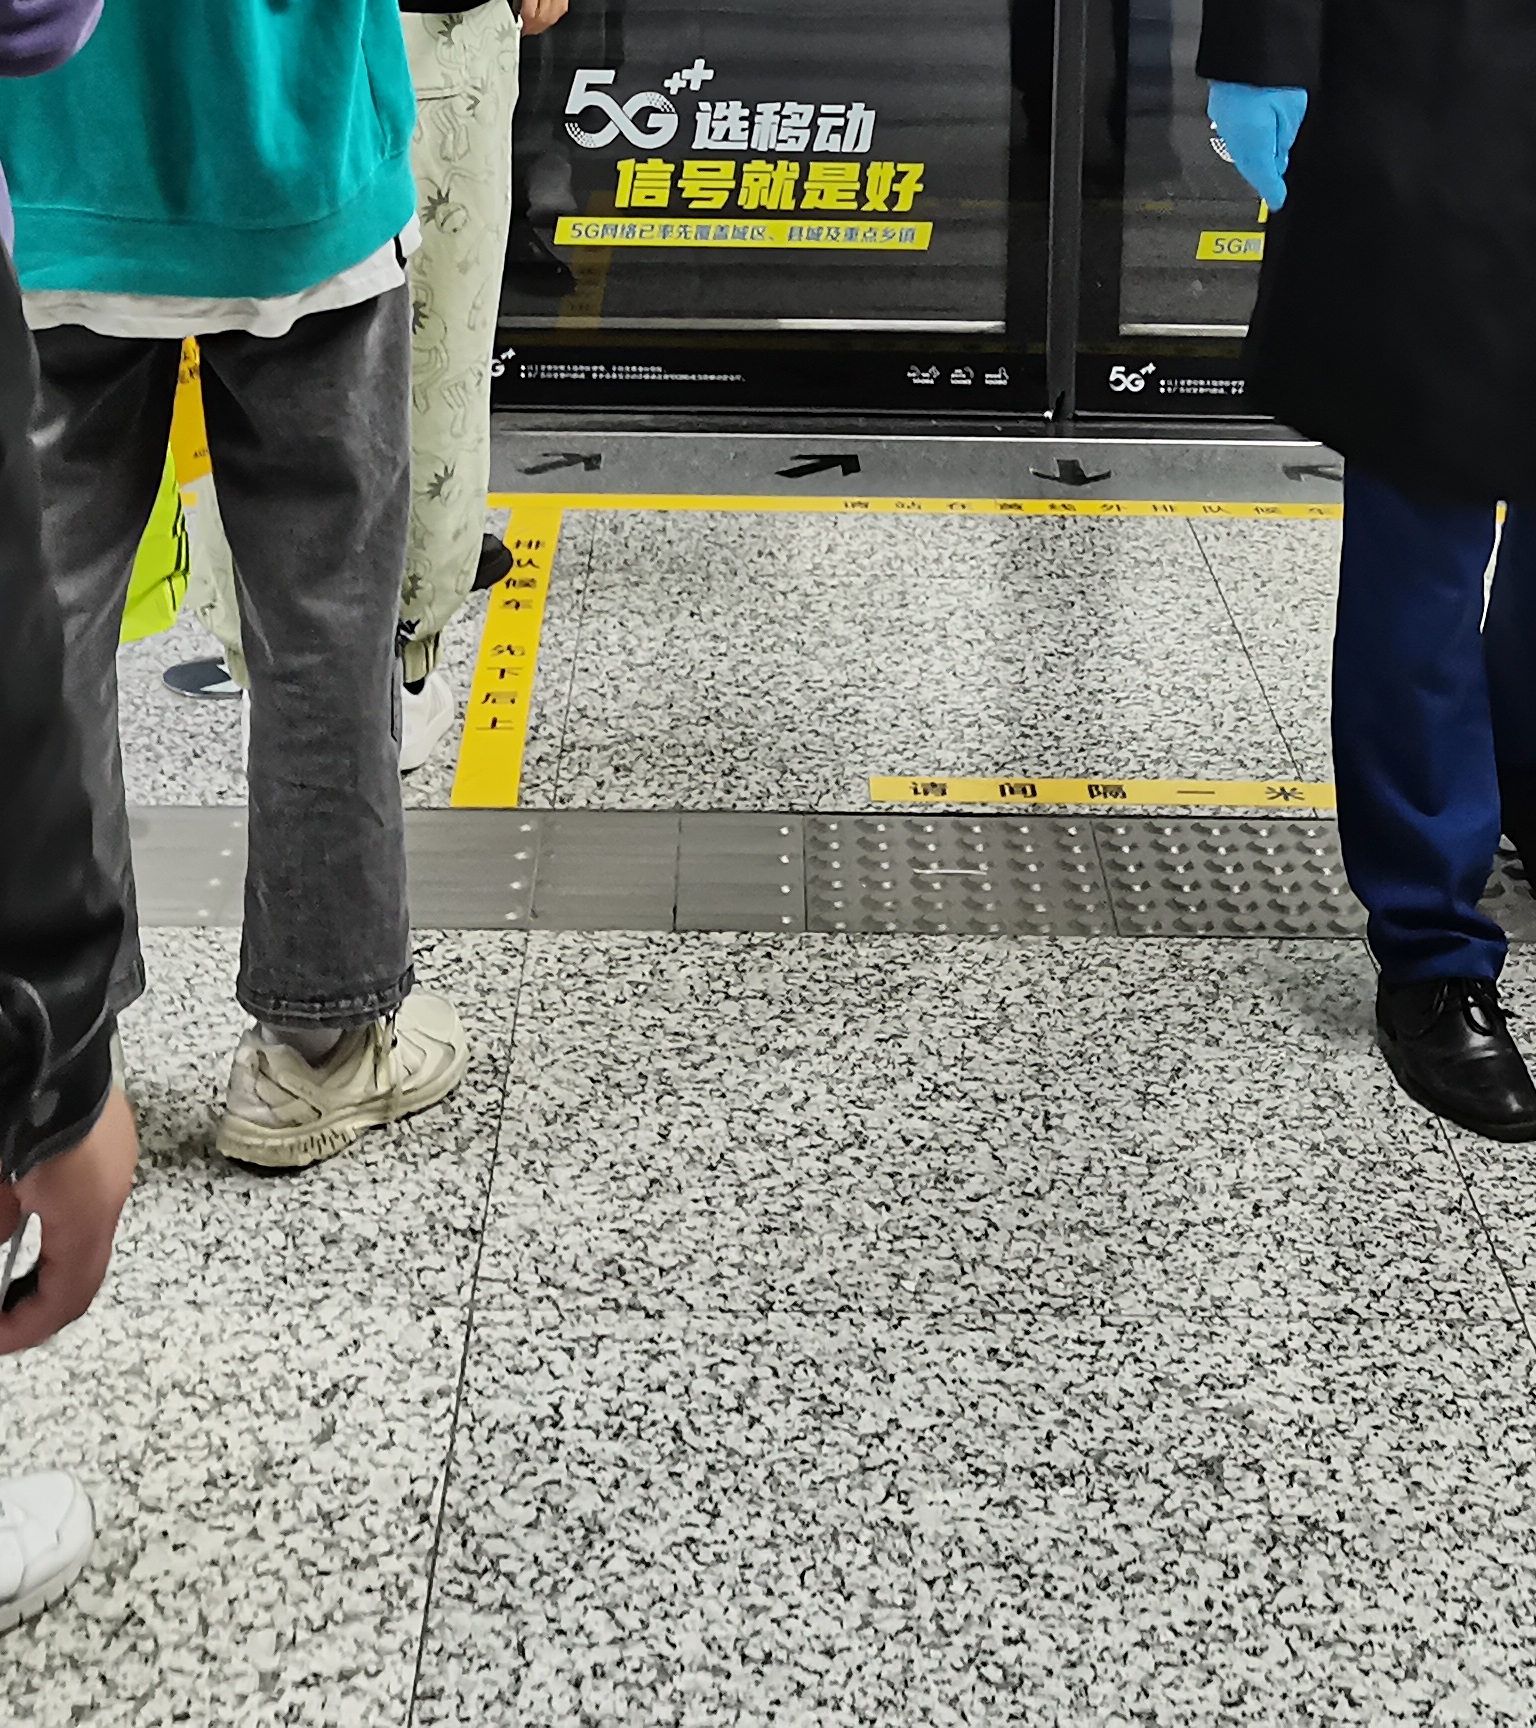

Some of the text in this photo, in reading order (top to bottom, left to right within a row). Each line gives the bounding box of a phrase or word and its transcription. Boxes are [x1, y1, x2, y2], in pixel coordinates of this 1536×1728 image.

[691, 100, 876, 154] 选移动
[614, 157, 925, 212] 信号就是好
[909, 781, 1306, 802] 请间隔一米
